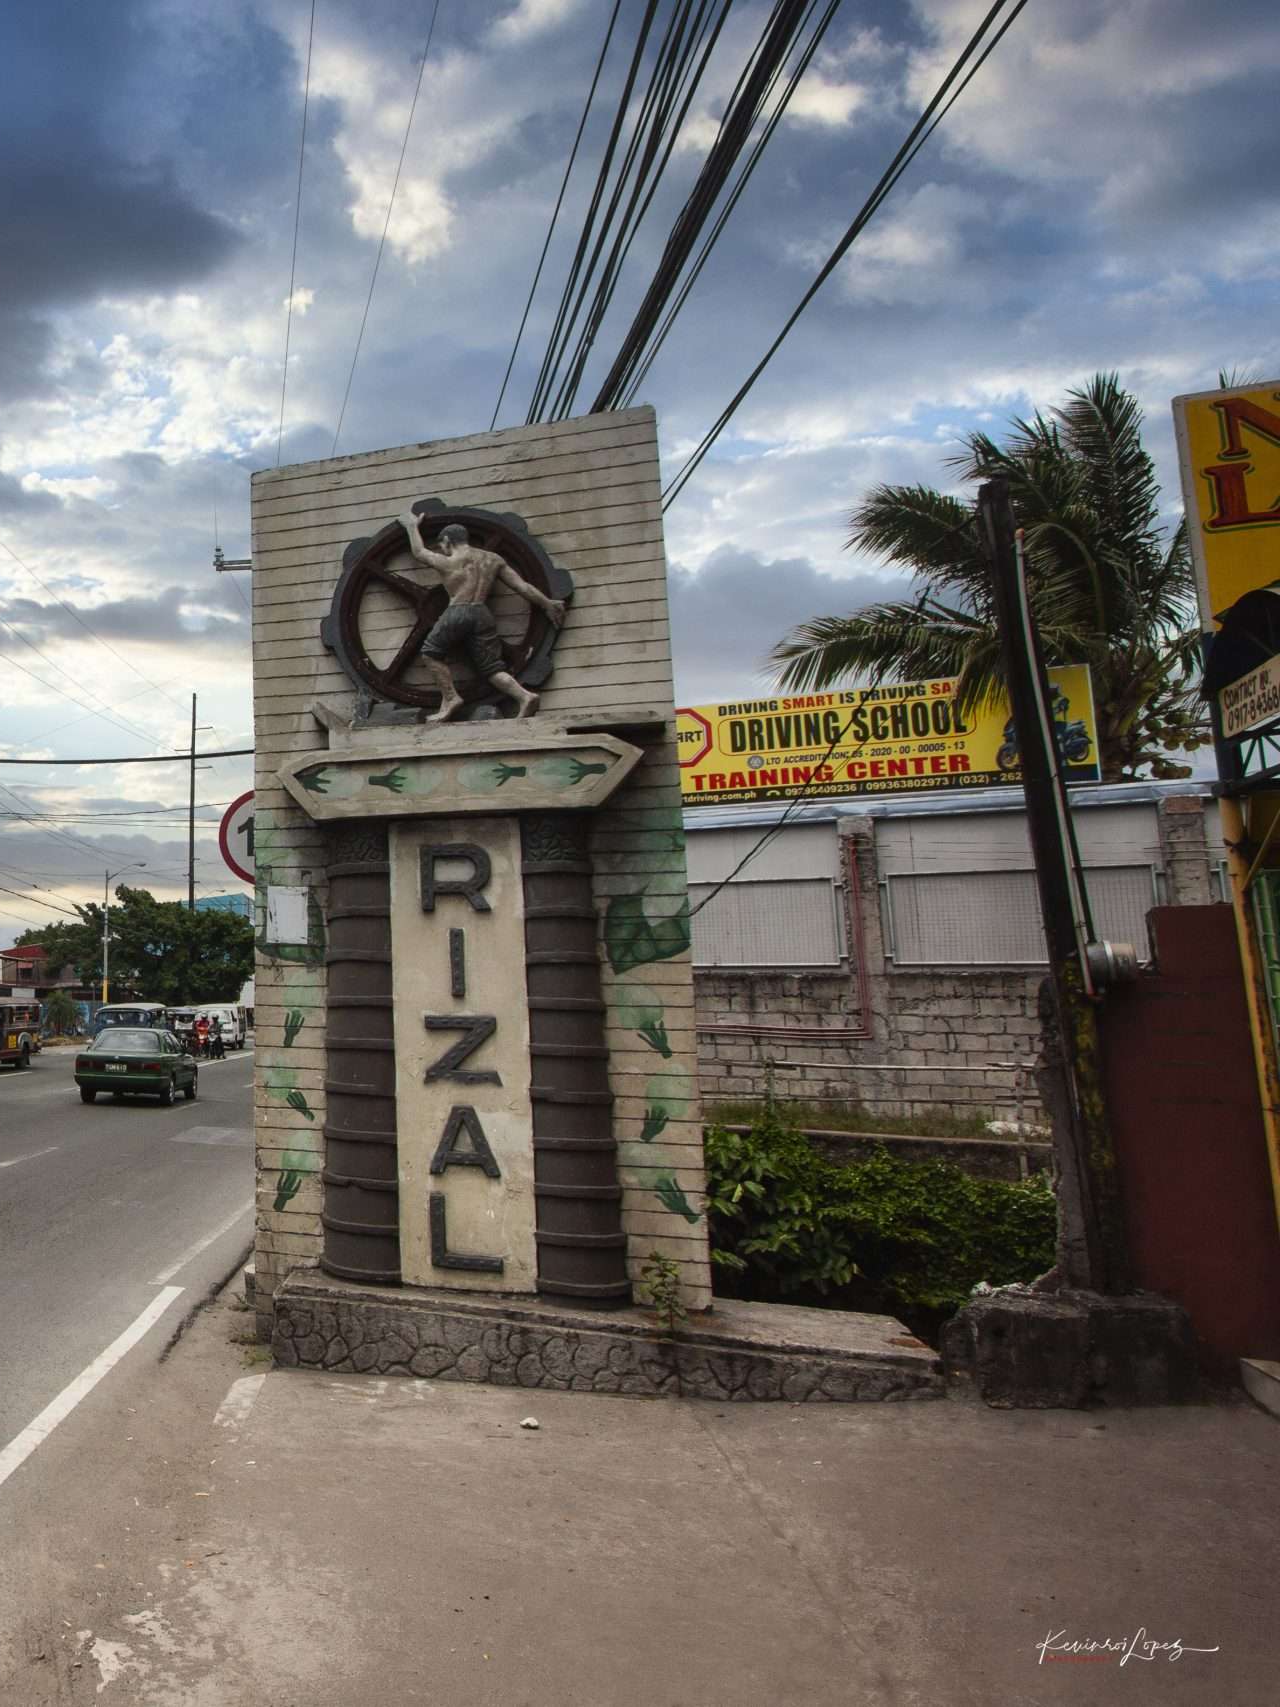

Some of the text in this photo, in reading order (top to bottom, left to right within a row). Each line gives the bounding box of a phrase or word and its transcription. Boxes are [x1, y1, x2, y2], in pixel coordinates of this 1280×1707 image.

[718, 700, 778, 717] DRIVING
[783, 694, 834, 710] SMART
[840, 692, 855, 704] IS
[859, 684, 926, 702] DRIVING
[730, 699, 967, 753] DRIVING SCHOOL
[766, 757, 780, 766] LTO
[871, 747, 892, 757] 2020
[899, 746, 910, 754] 00
[918, 743, 946, 753] 00005
[954, 741, 965, 750] 13
[690, 753, 971, 791] TRAINING CENTER
[959, 774, 990, 786] (032)
[1000, 771, 1023, 782] 262
[422, 843, 504, 1274] RIZAL
